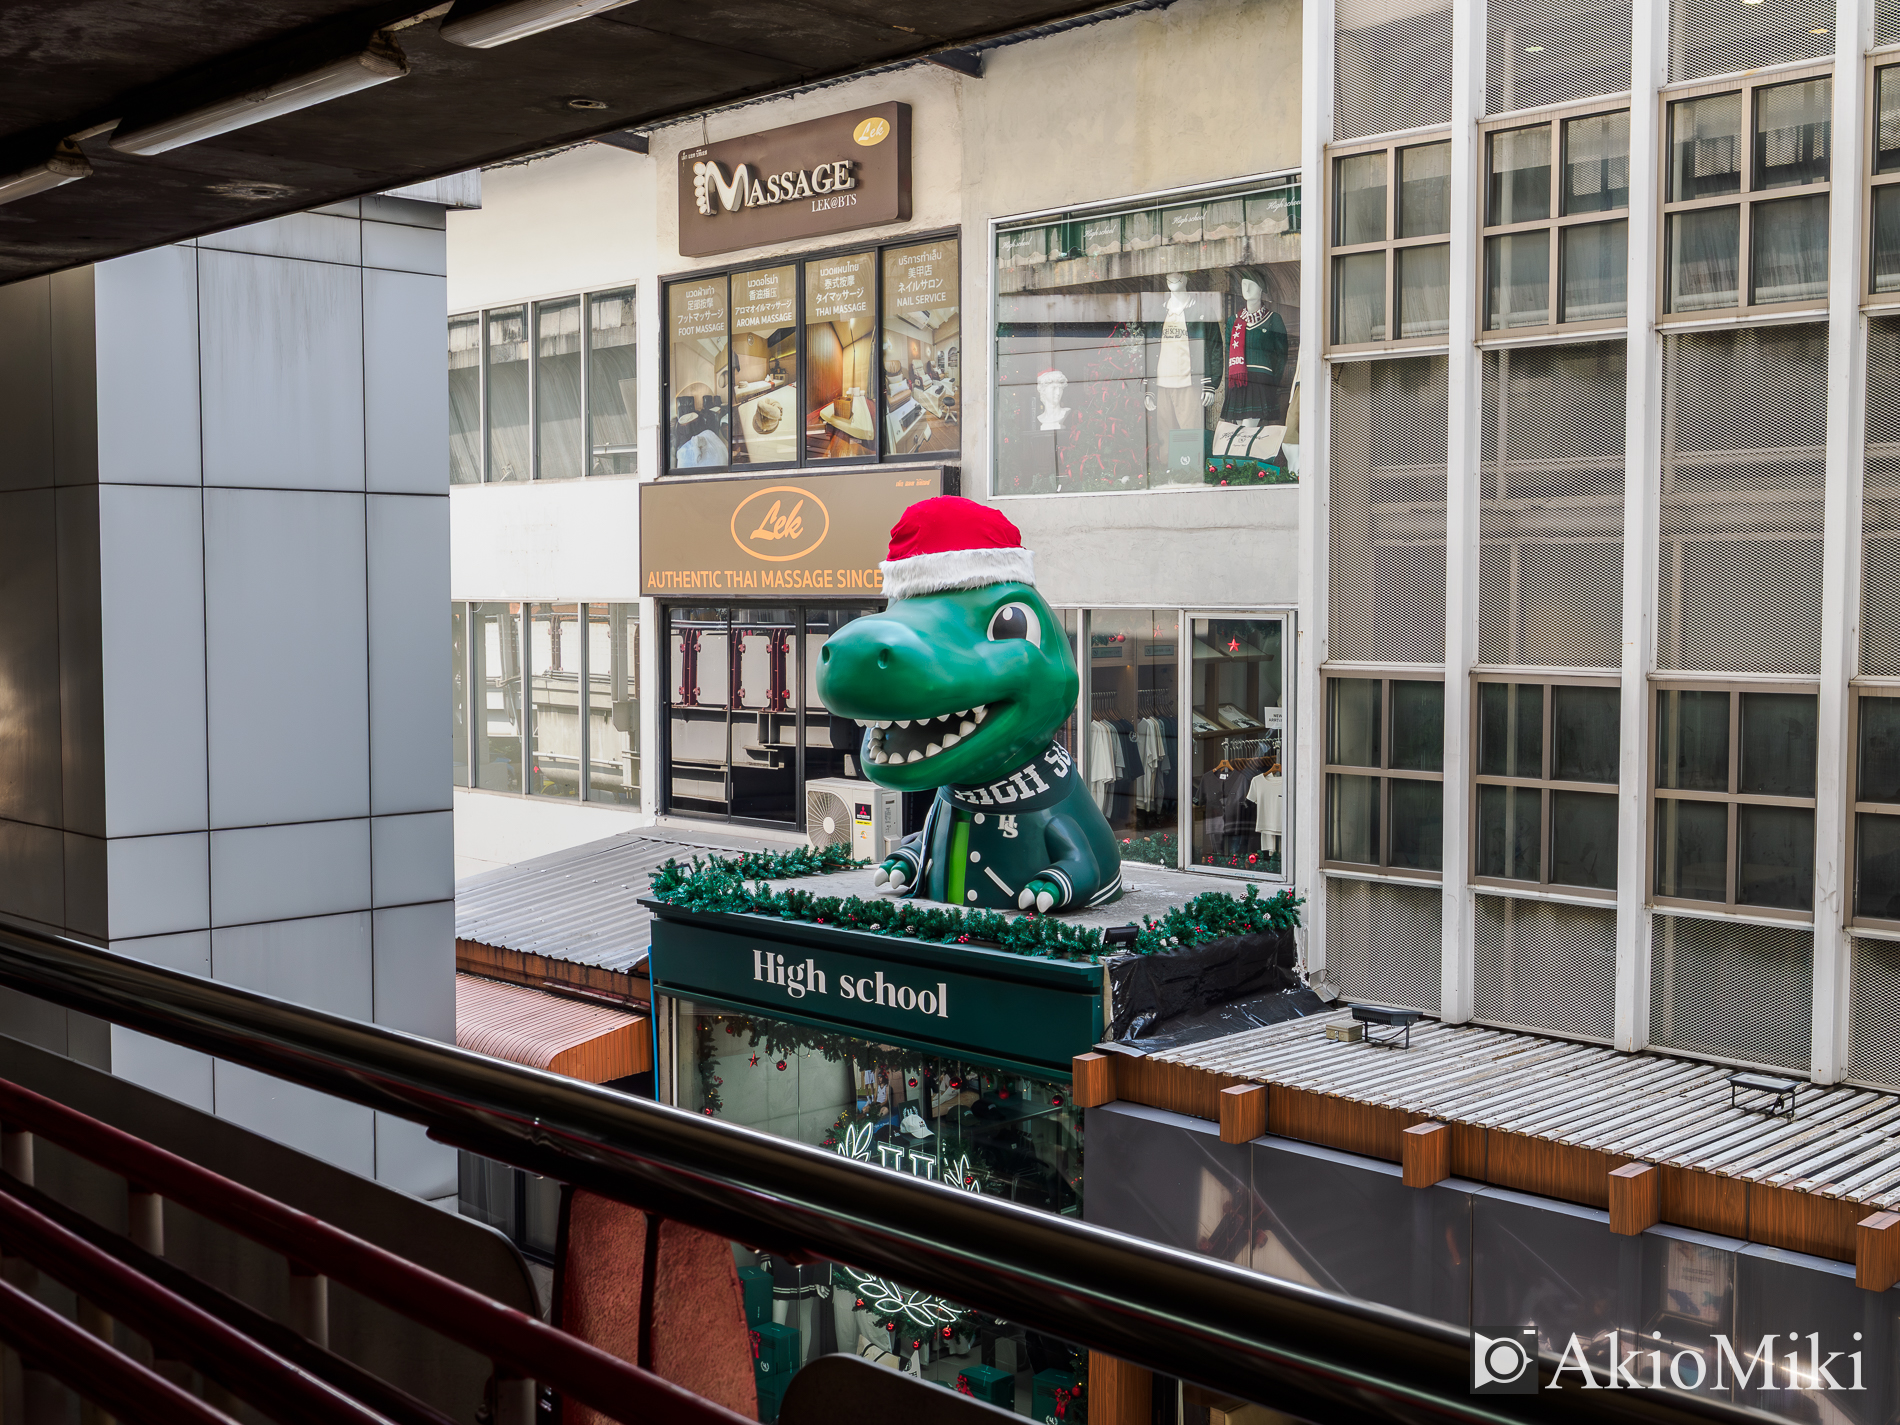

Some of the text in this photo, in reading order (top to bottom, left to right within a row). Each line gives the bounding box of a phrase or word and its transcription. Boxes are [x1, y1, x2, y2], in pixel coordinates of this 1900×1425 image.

[857, 122, 885, 144] Lek
[811, 193, 858, 213] LEK@BTS
[907, 264, 933, 279] 美甲店
[824, 274, 855, 290] 泰式按摩
[897, 278, 944, 294] ネイルサロン
[815, 286, 865, 304] タイマッサージ
[896, 291, 947, 307] NAIL SERVICE
[734, 299, 793, 316] アロマオイルマッサージ
[815, 301, 867, 317] THAI MASSAGE
[677, 308, 724, 325] フットマッサージ
[736, 312, 793, 328] AROMA MASSAGE
[678, 322, 725, 336] FOOT MASSAGE
[749, 499, 804, 541] Lek
[647, 569, 883, 588] AUTHENTIC THAI MASSAGE SINCE
[954, 763, 1050, 805] HIGH
[752, 949, 949, 1018] High school
